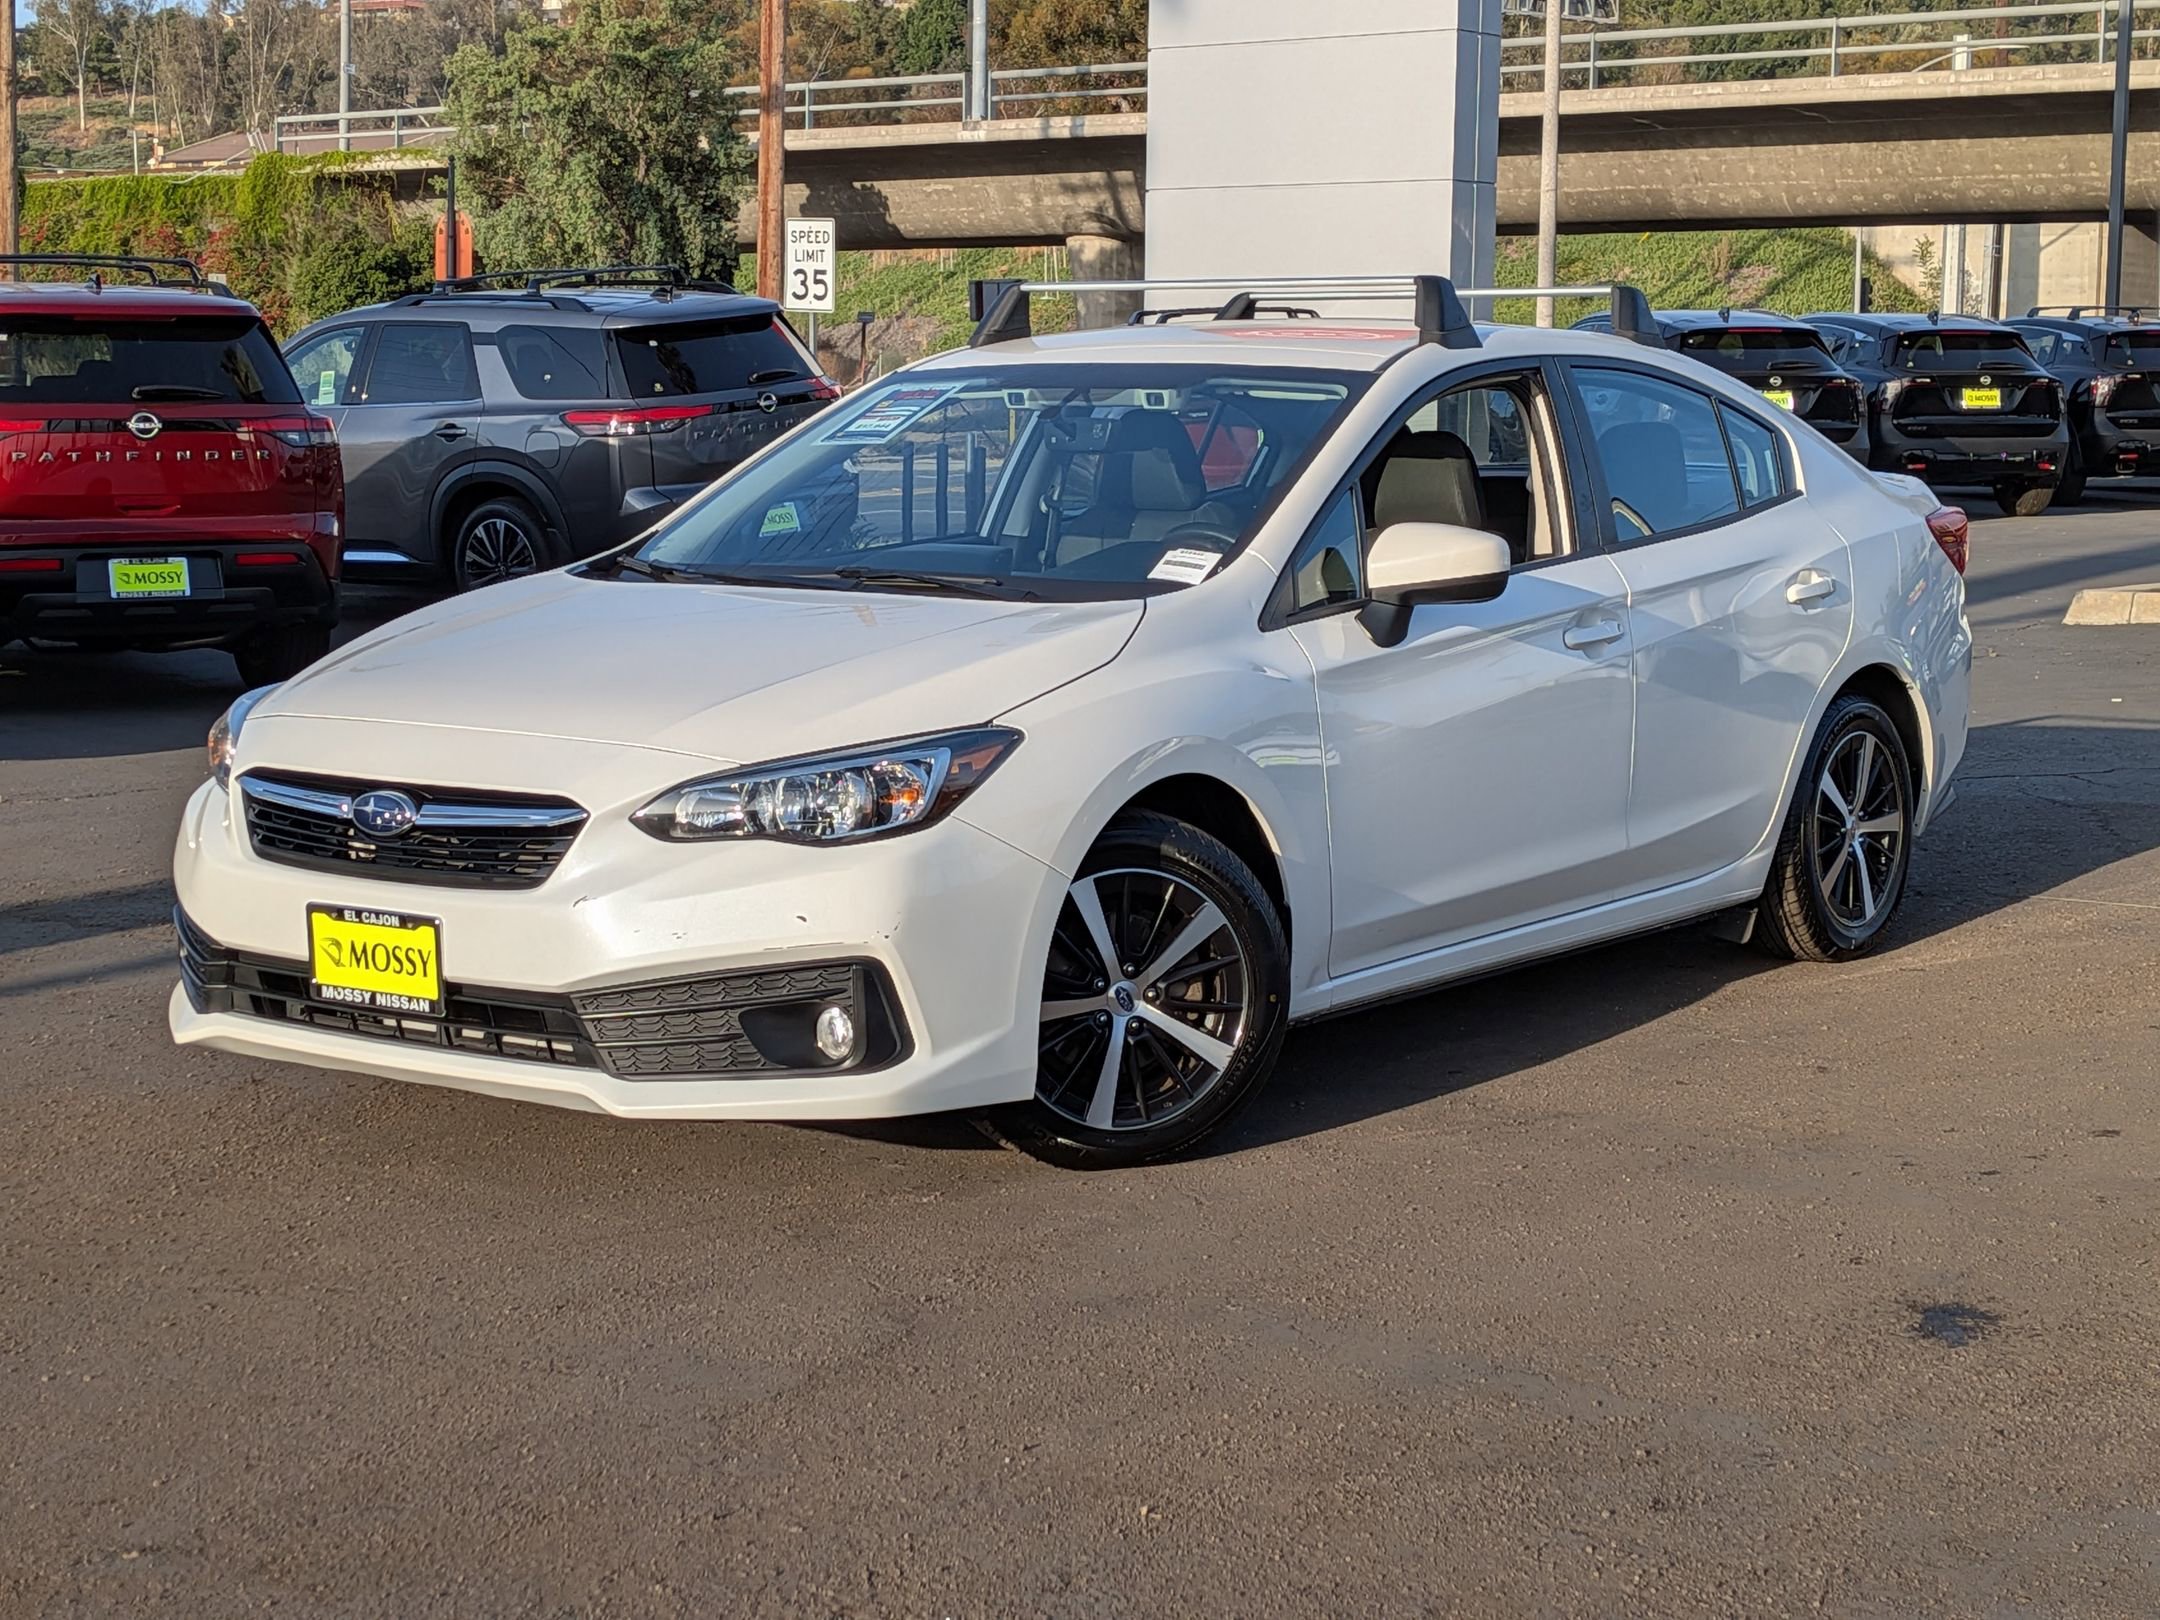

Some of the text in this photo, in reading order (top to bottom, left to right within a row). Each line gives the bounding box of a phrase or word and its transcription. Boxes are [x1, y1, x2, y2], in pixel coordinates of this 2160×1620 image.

[791, 230, 830, 244] SPEED
[795, 249, 825, 263] LIMIT
[792, 268, 828, 301] 35
[11, 449, 271, 463] PATHFINDER
[134, 571, 182, 585] MOSSY
[344, 909, 400, 927] EL CAJON
[350, 939, 431, 977] MOSSY
[321, 985, 430, 1012] MOSSY NISSAN
